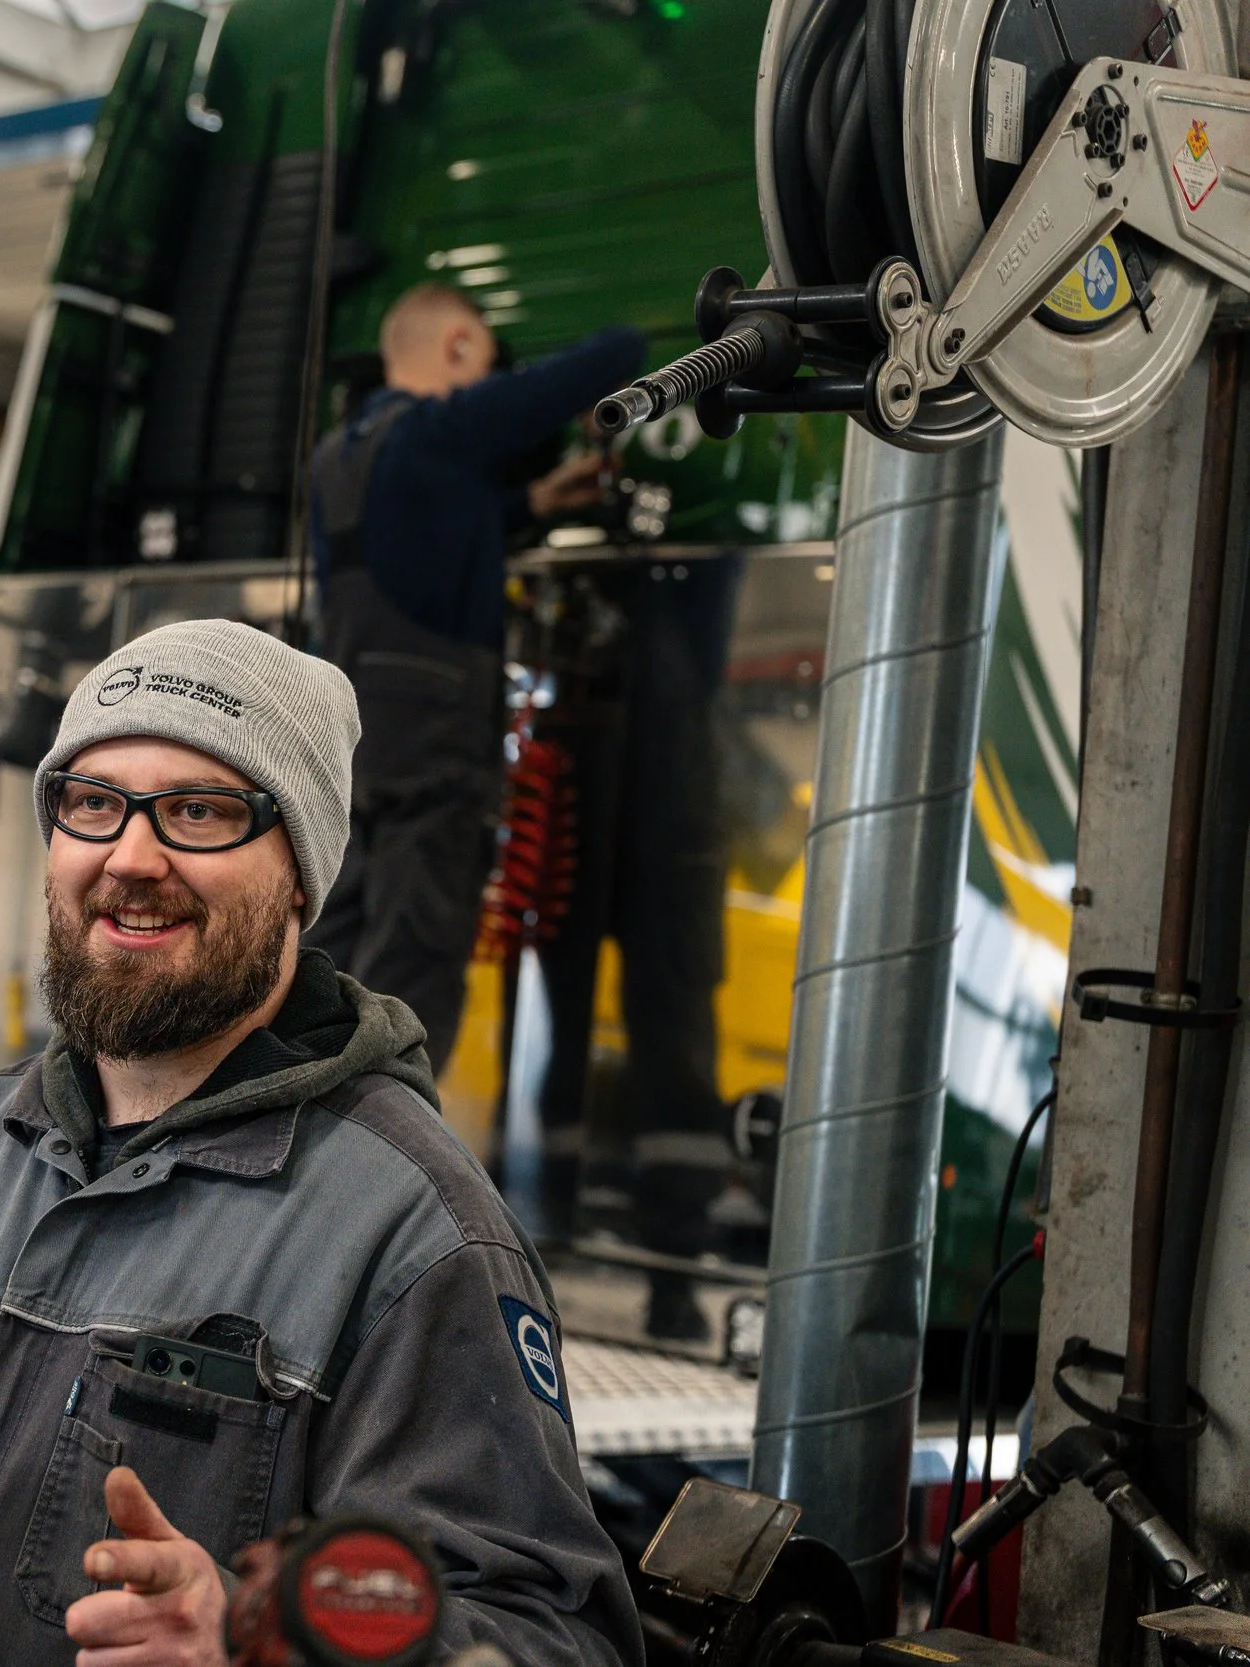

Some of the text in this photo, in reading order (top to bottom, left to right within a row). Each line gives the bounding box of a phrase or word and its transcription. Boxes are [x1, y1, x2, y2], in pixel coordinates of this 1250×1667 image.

[996, 202, 1053, 286] RAASM
[103, 681, 135, 693] VOLVO
[145, 684, 241, 719] TRUCK CENTER
[151, 674, 242, 708] VOLVO GROUP
